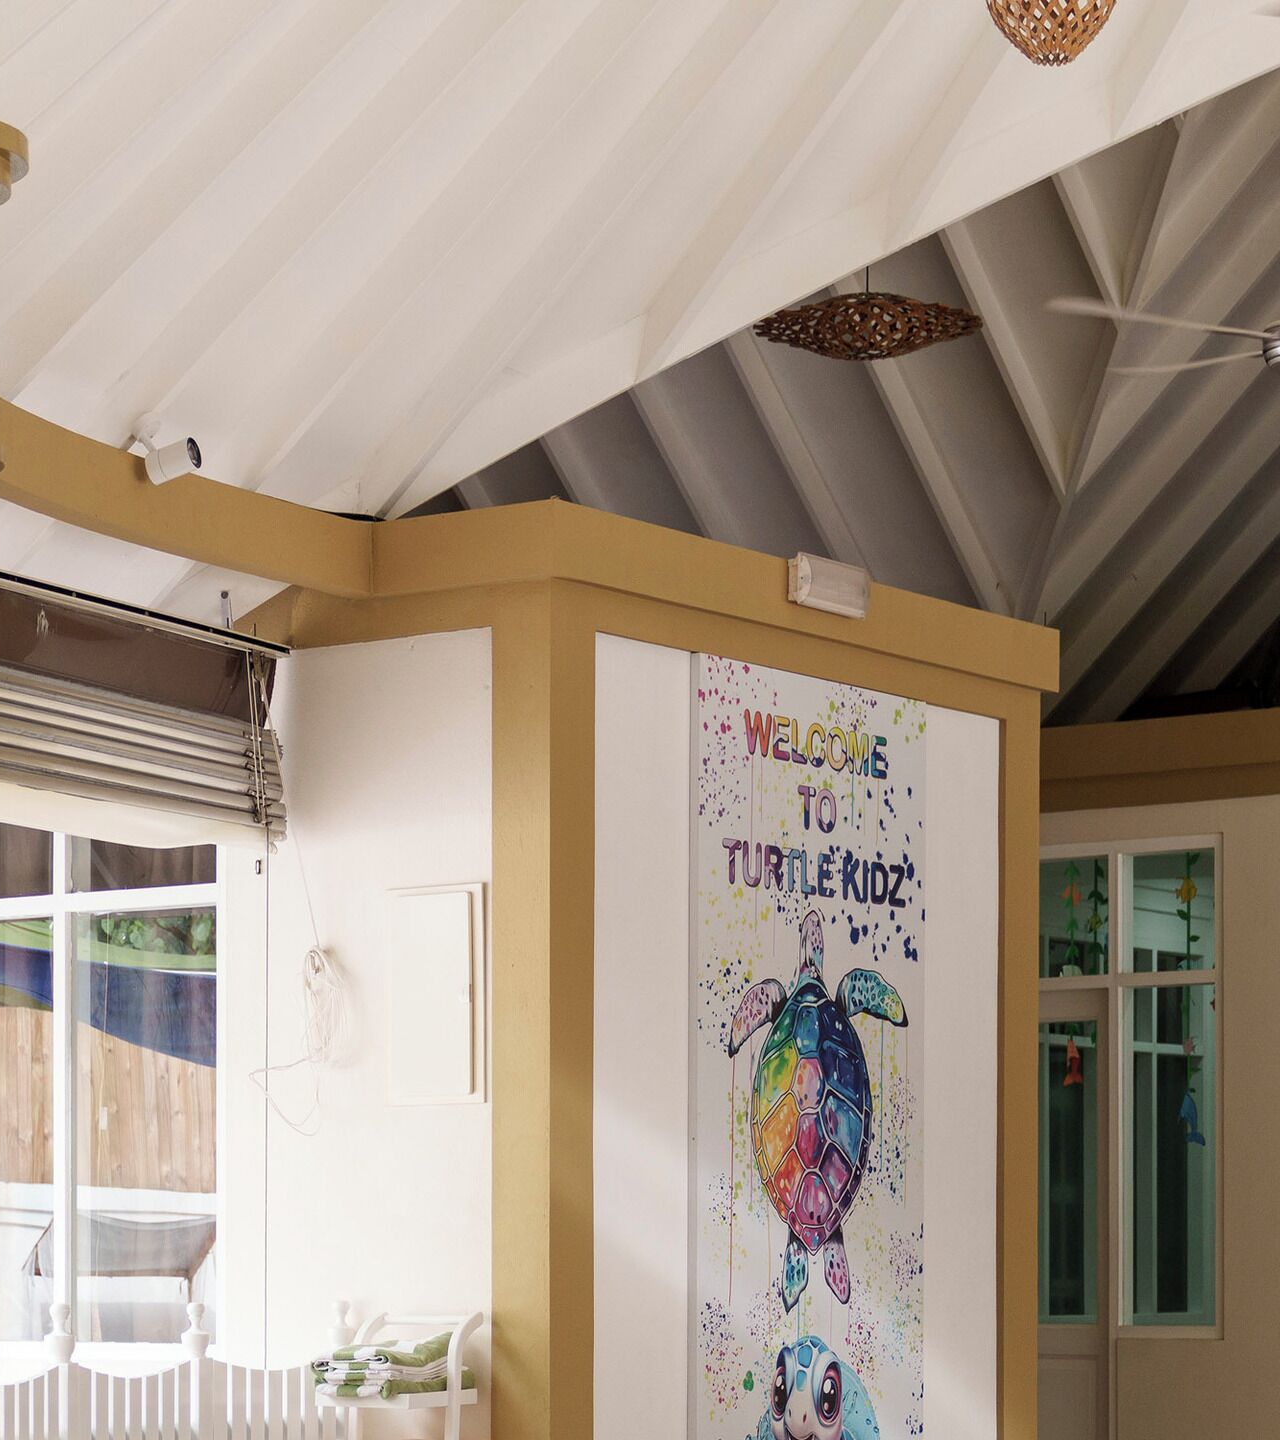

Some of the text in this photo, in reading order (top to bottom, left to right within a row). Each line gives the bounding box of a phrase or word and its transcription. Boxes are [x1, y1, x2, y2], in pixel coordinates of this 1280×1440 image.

[744, 708, 888, 779] WELCOME
[798, 784, 837, 833] TO
[722, 837, 907, 908] TURTLE KIDZ
